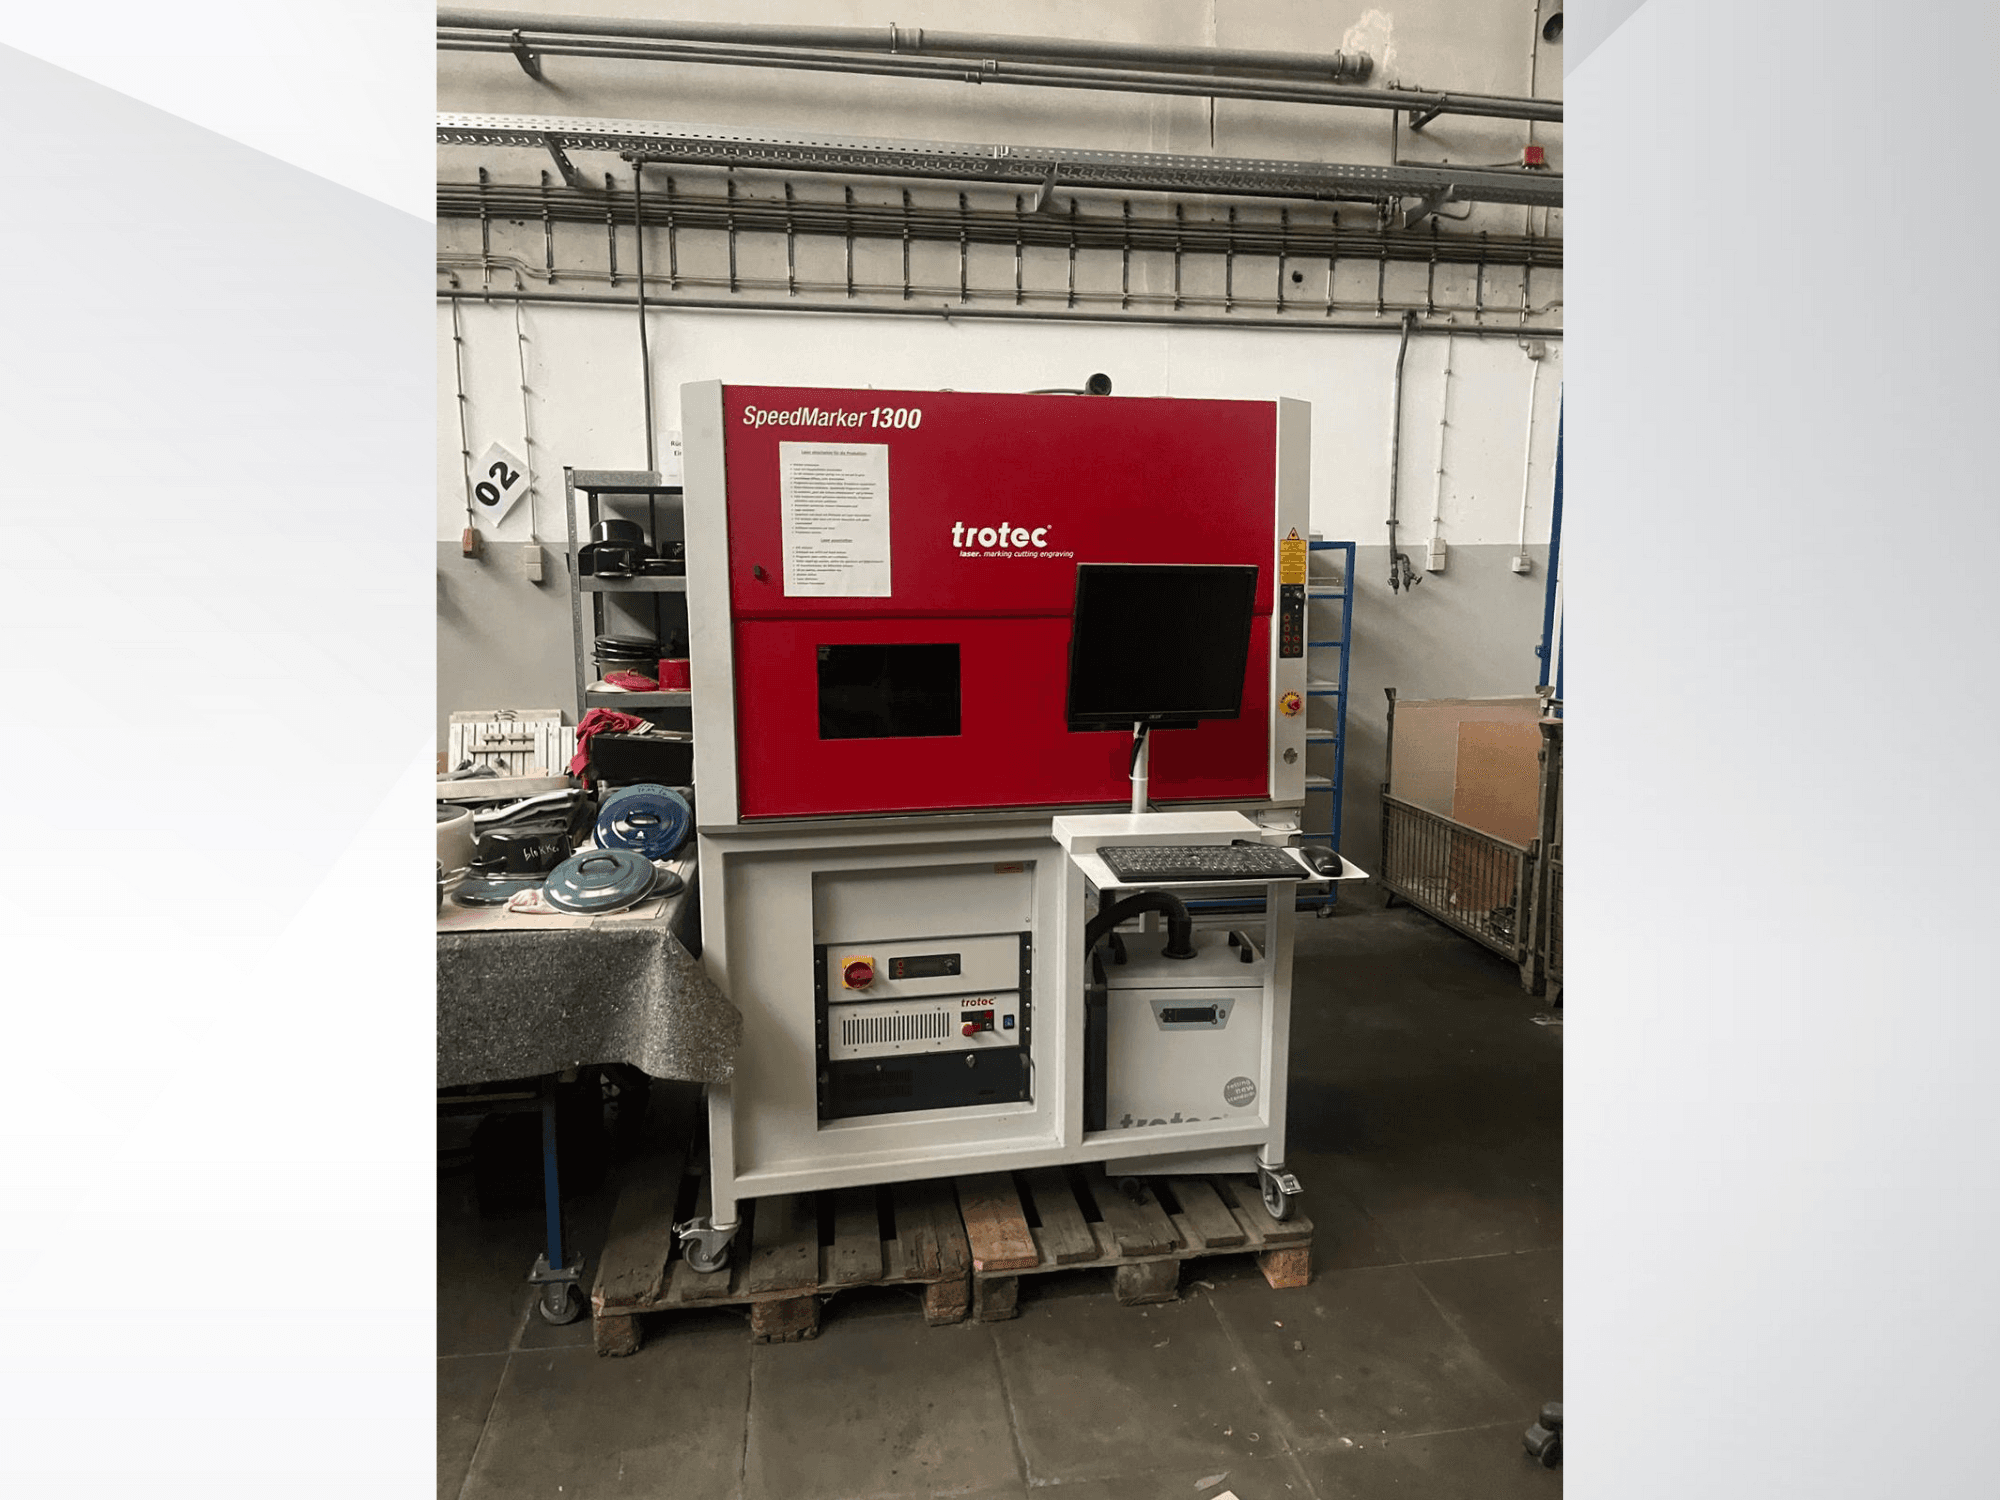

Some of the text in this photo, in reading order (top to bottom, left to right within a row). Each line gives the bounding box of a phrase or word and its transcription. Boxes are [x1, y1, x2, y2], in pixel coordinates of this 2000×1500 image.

[742, 405, 922, 430] SpeedMarker 1300
[475, 461, 520, 507] 02
[951, 521, 1048, 548] trotec
[959, 550, 1074, 559] laser. marking cutting engraving
